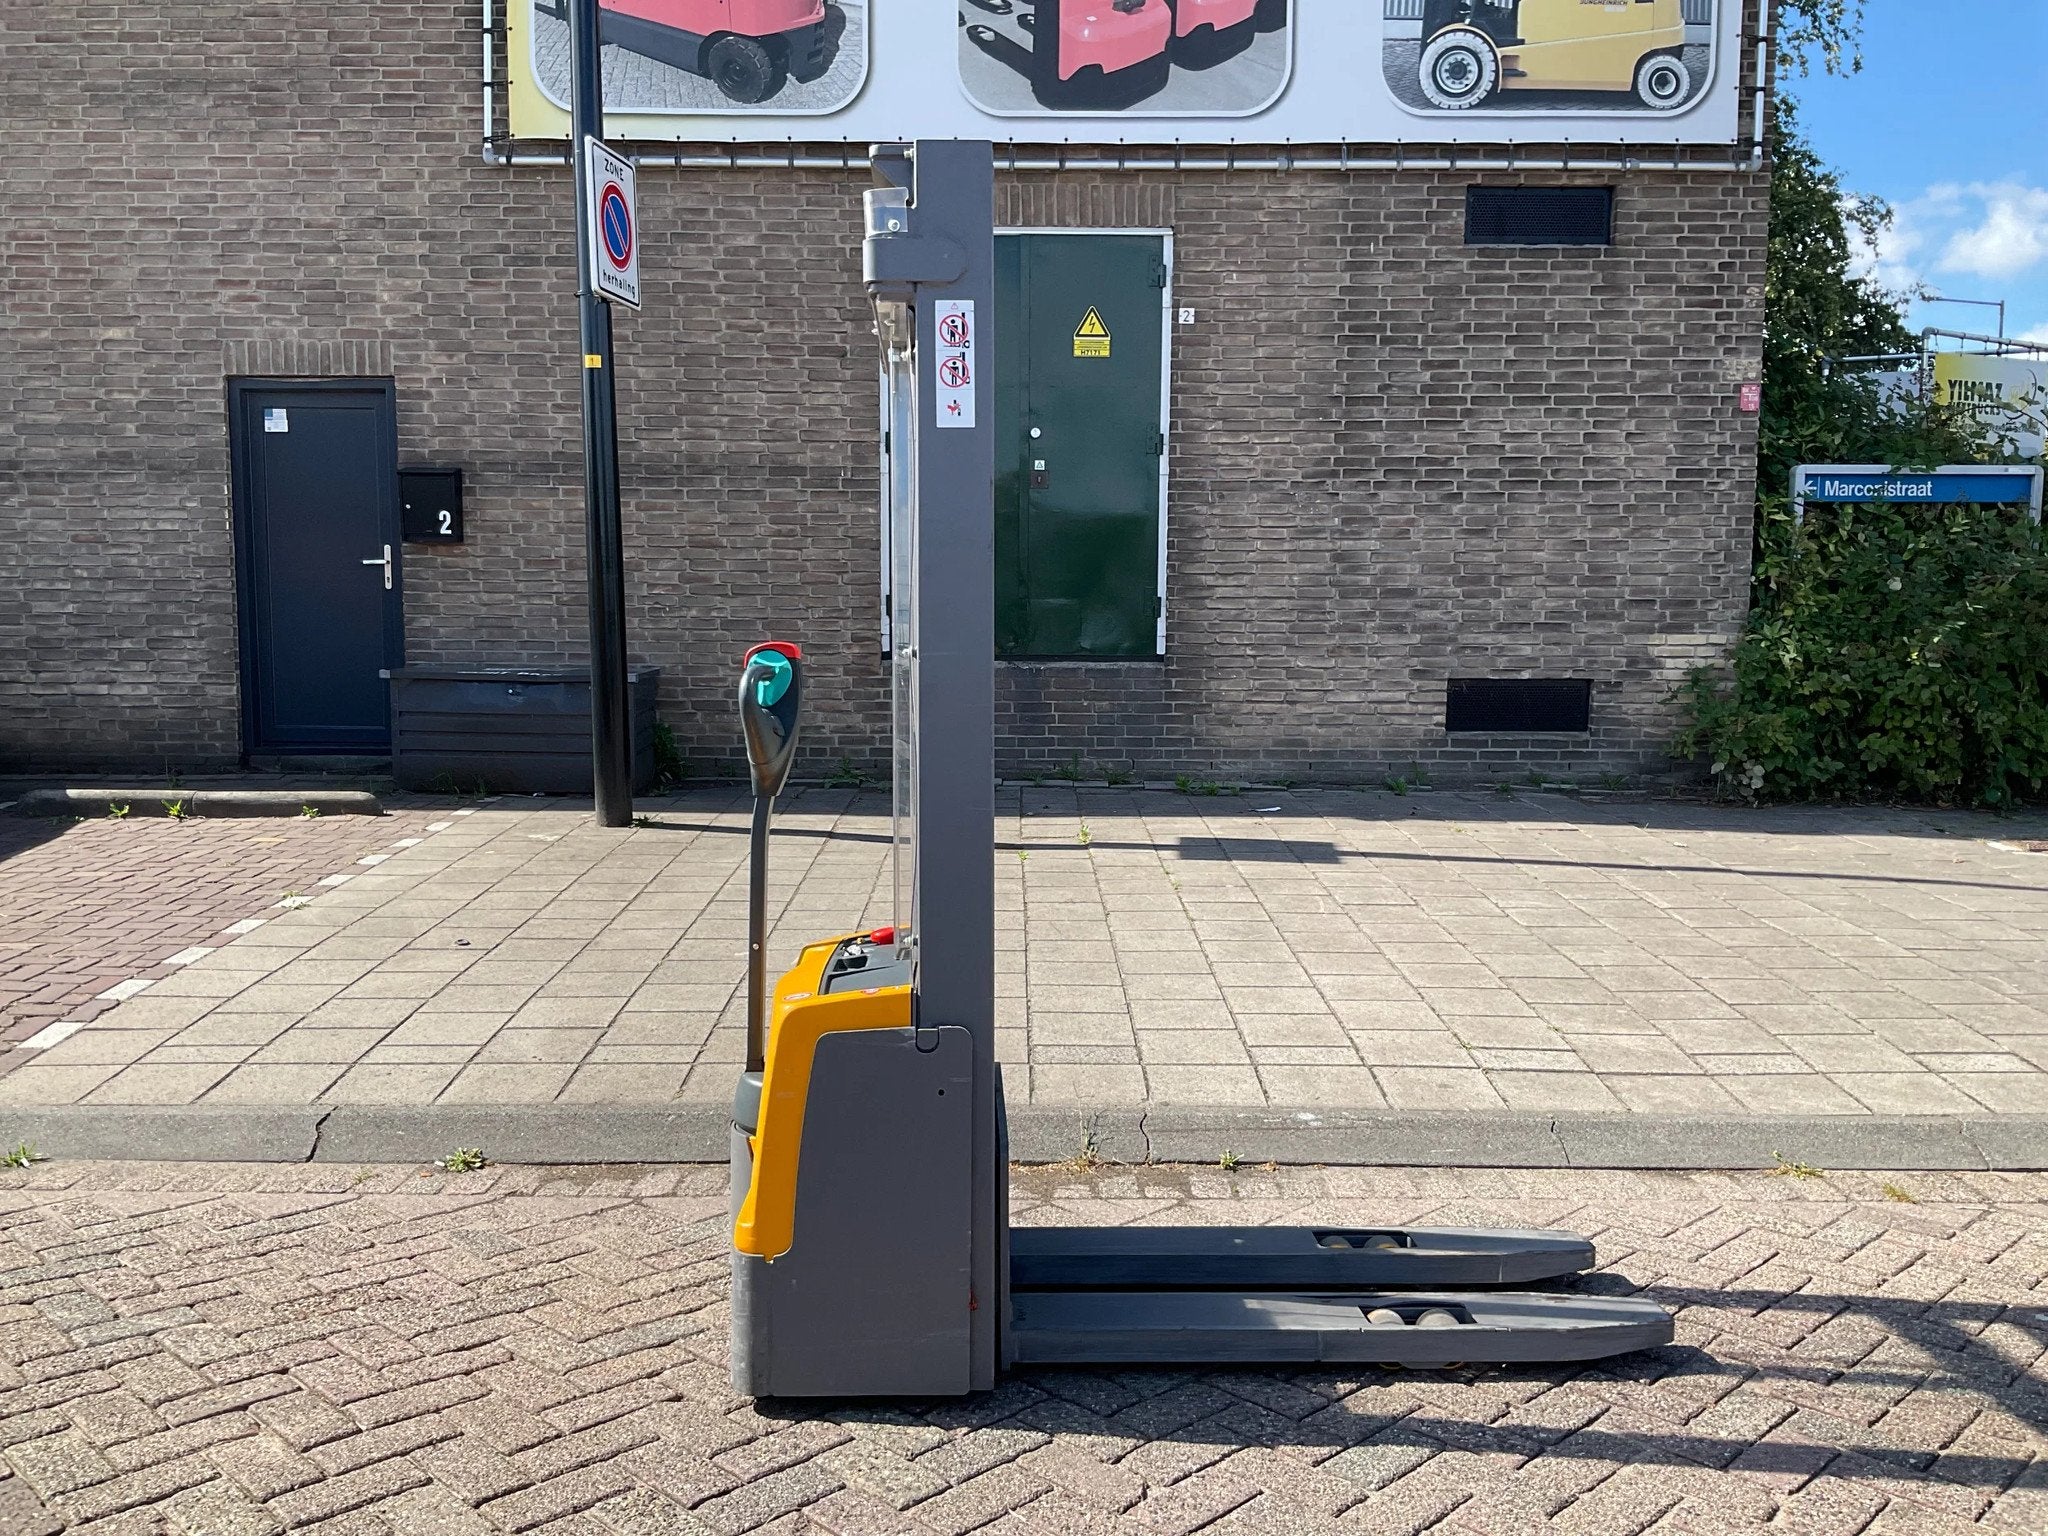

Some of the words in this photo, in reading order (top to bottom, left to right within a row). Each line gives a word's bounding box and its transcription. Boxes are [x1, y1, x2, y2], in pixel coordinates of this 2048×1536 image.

[604, 158, 625, 182] ZONE
[602, 269, 636, 299] herhaling
[1183, 309, 1190, 322] 2
[438, 510, 452, 535] 2
